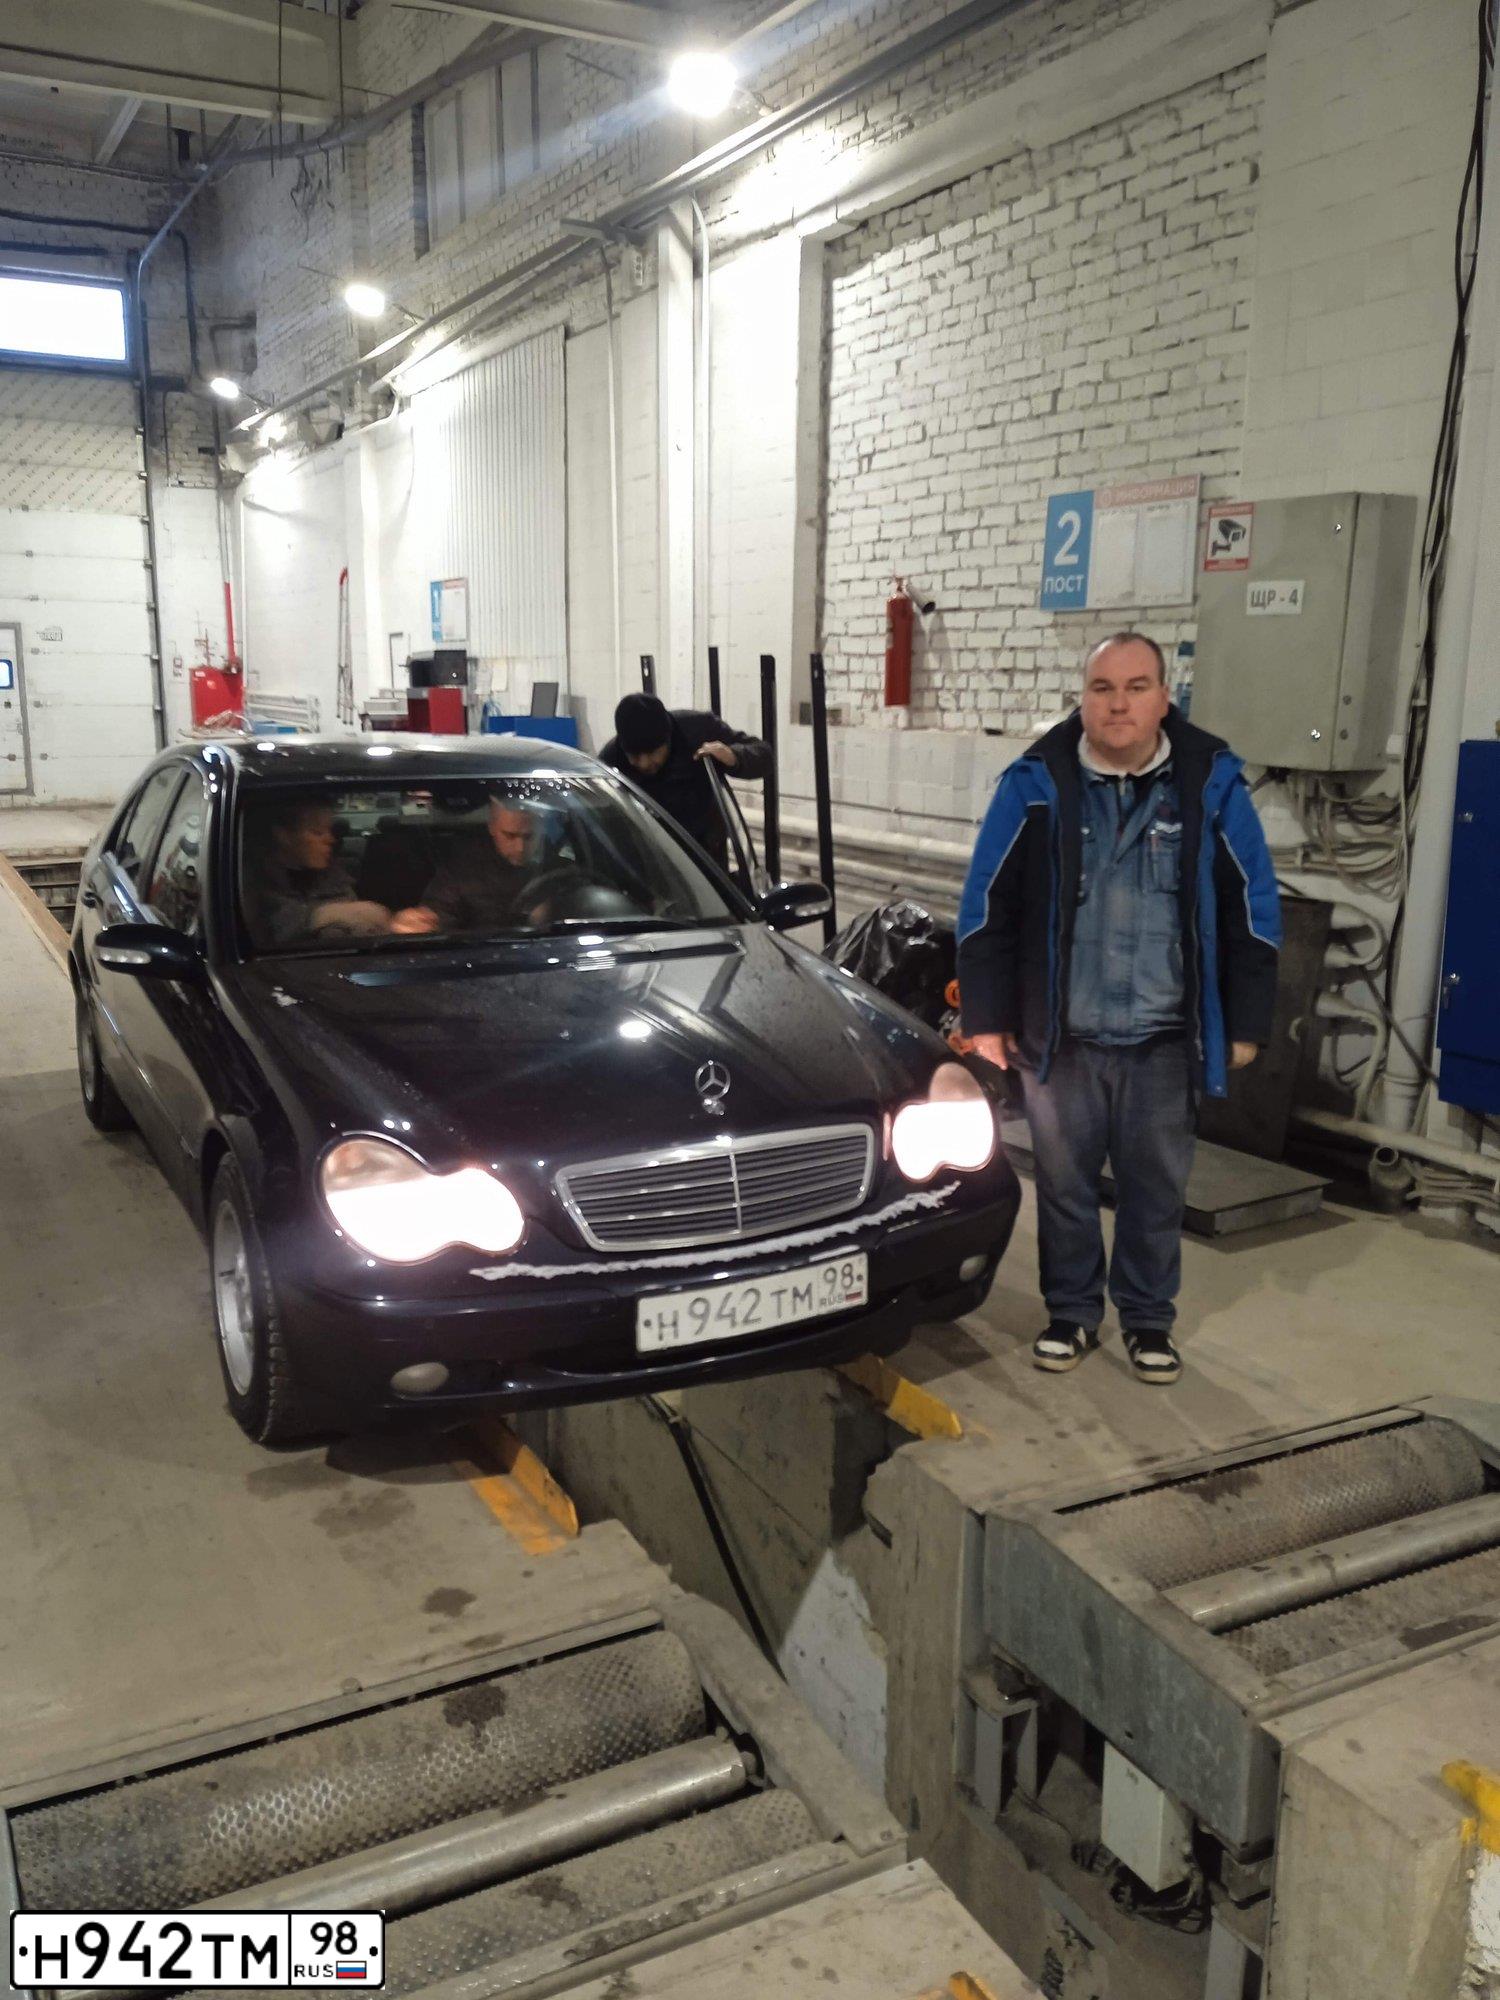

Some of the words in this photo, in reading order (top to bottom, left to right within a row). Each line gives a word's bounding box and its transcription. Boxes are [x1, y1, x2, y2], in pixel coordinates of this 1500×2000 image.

[1054, 509, 1080, 566] 2
[1044, 574, 1084, 593] ПОСТ
[823, 1263, 854, 1294] 98
